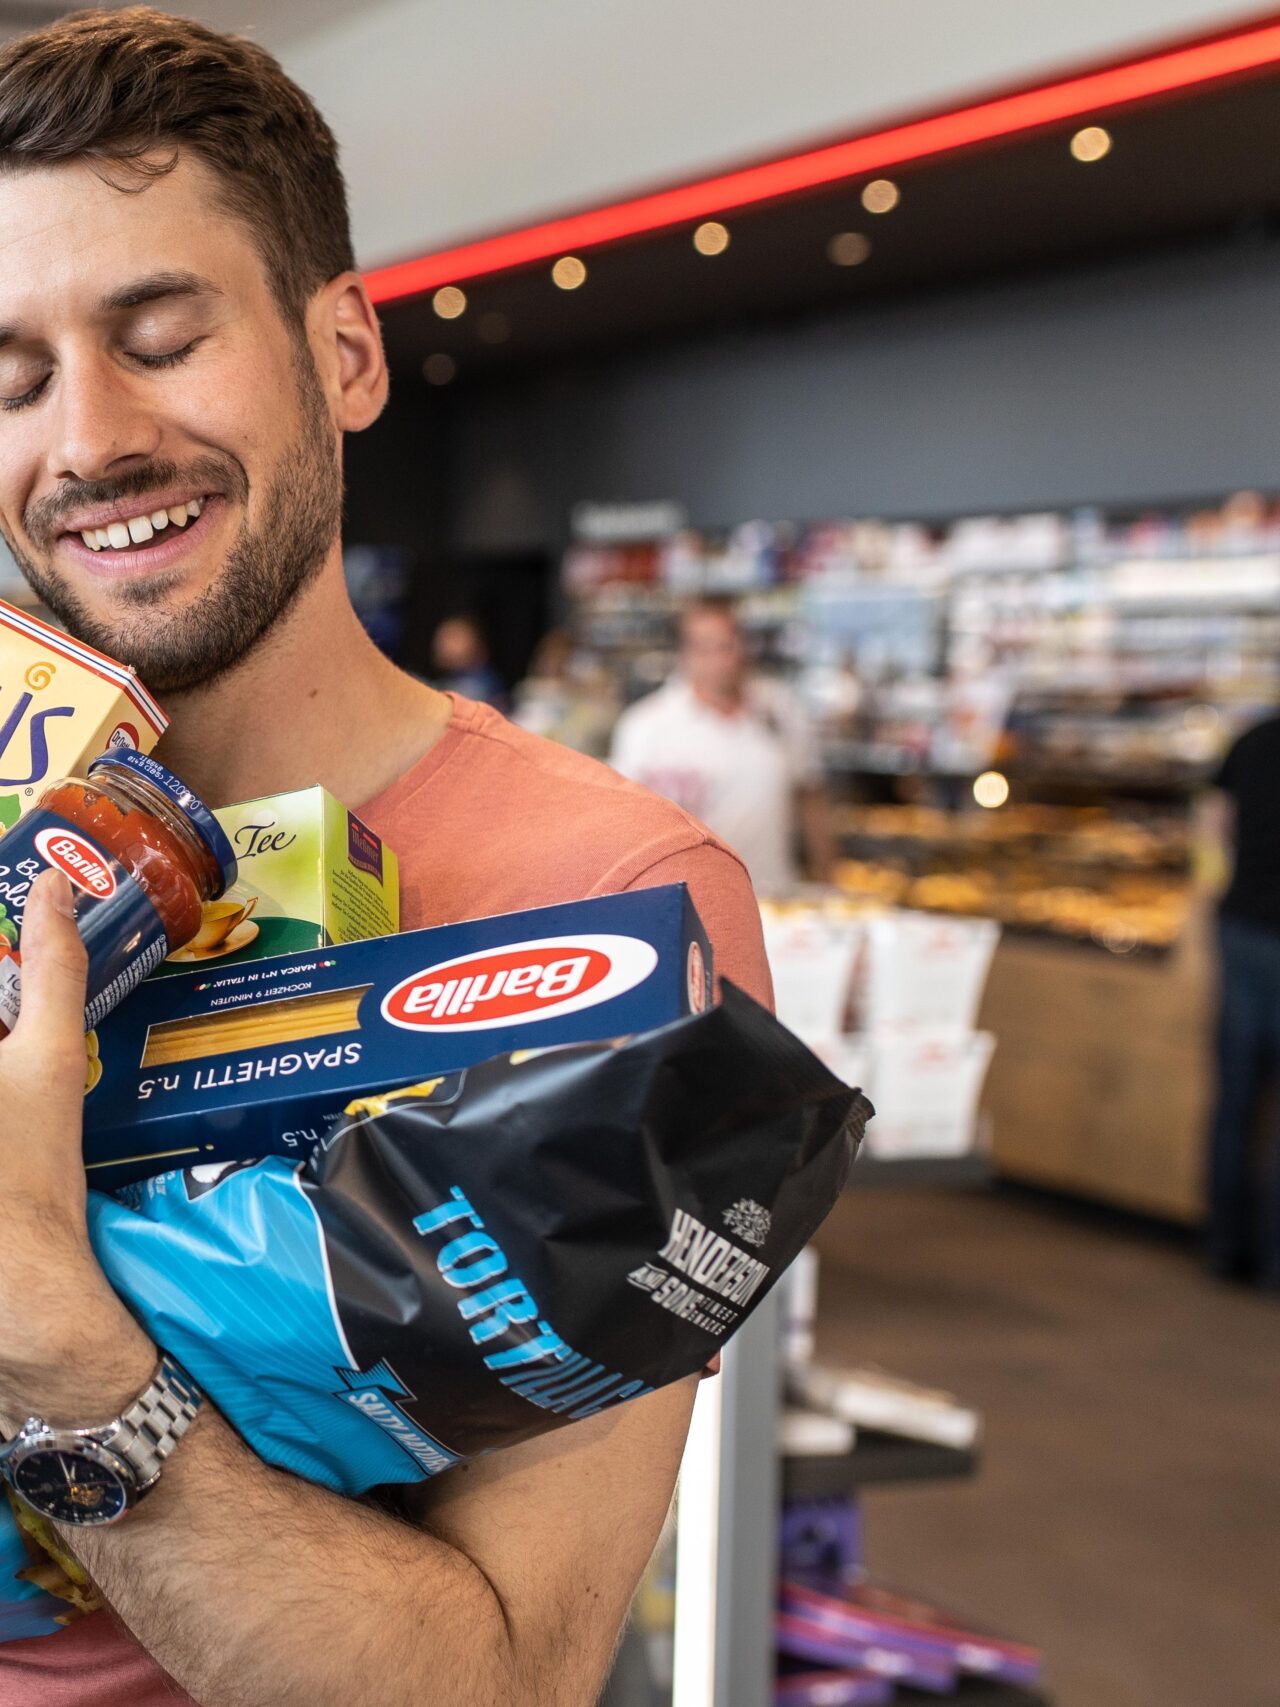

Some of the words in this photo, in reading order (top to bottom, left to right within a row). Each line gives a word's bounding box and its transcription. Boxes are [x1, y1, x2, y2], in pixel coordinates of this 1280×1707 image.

[234, 821, 297, 861] Tee
[49, 838, 111, 893] Barilla
[279, 962, 317, 977] MARCA
[405, 956, 592, 1018] Barilla
[210, 992, 252, 1006] MINUTEN
[263, 981, 312, 997] KOCHZEIT
[193, 1042, 362, 1091] SPAGHETTI
[138, 1076, 179, 1100] n.5
[282, 1128, 317, 1149] n.5
[657, 1207, 771, 1309] HENDERSON
[627, 1261, 666, 1291] AND
[653, 1273, 704, 1321] SONS
[347, 1392, 405, 1428] SALTY
